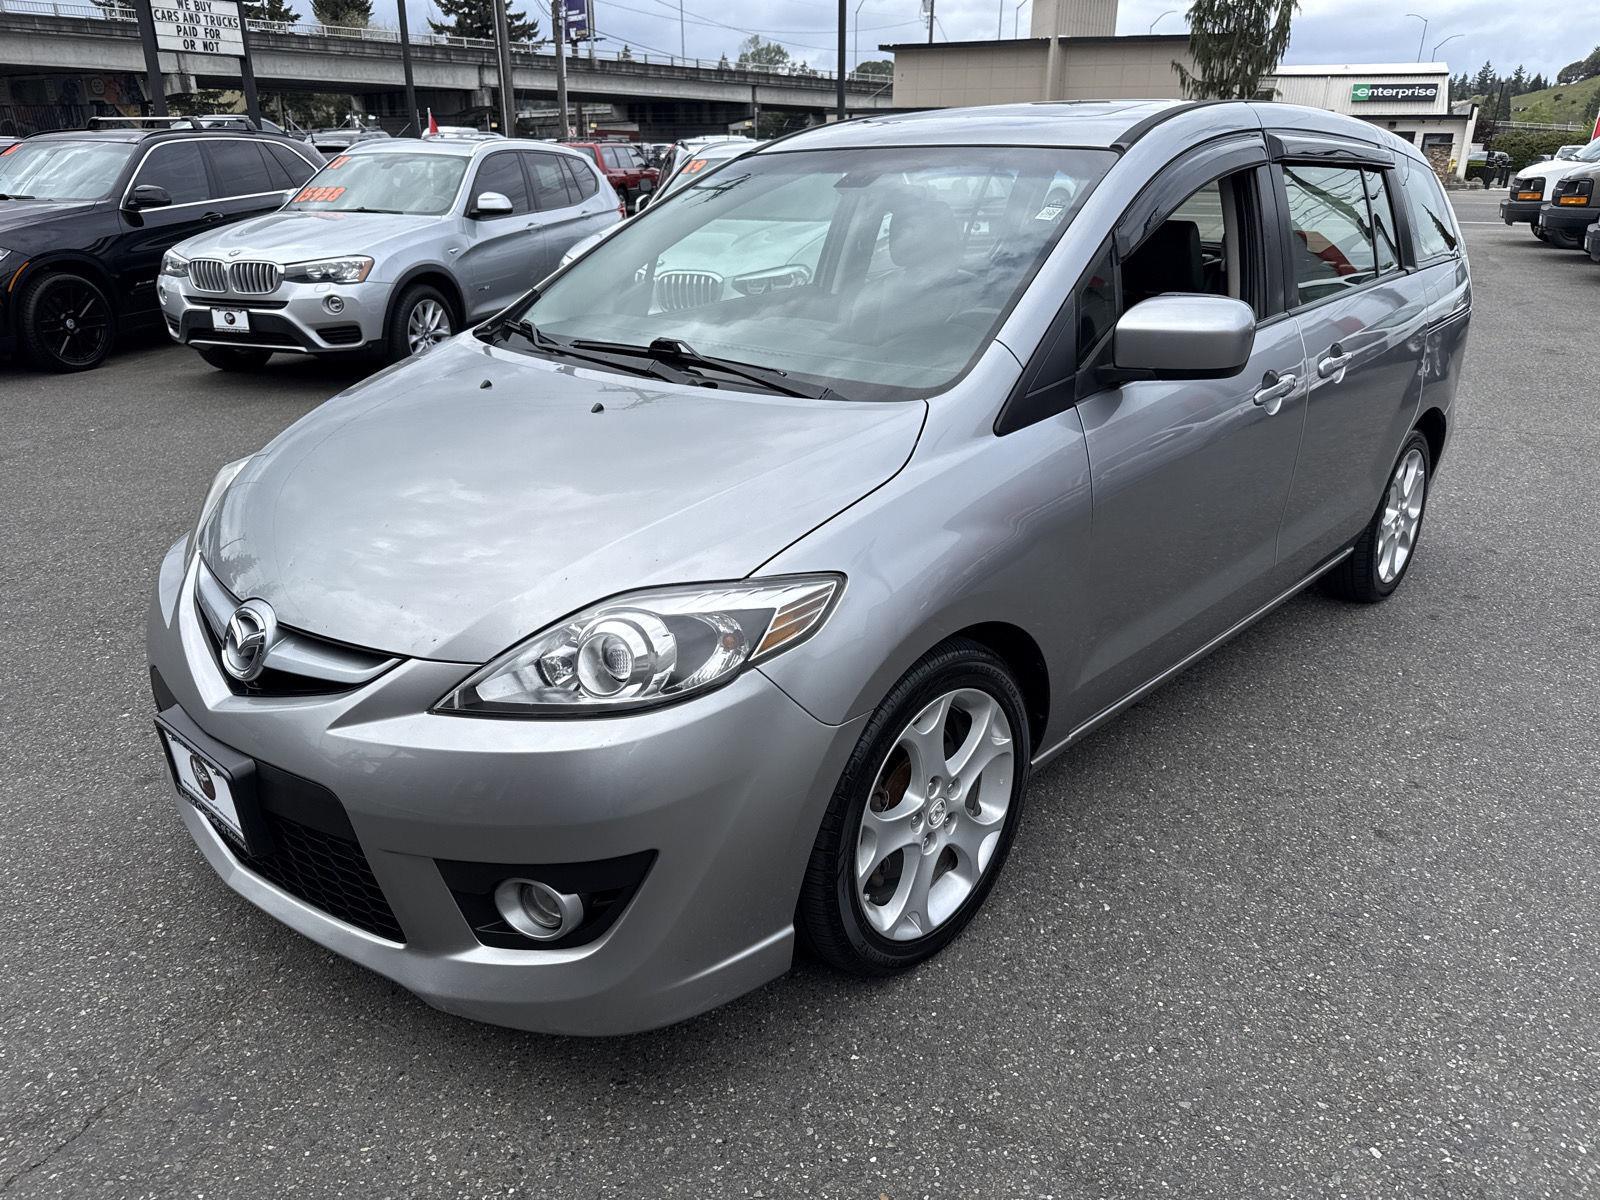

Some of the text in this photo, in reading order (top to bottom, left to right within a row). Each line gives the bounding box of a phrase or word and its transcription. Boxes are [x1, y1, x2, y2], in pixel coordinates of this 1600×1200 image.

[177, 0, 212, 12] WE BUY
[153, 9, 239, 28] CARS AND TRUCKS
[176, 25, 221, 39] PAID FOR
[183, 39, 220, 52] OR NOT
[1355, 86, 1437, 98] enterprise
